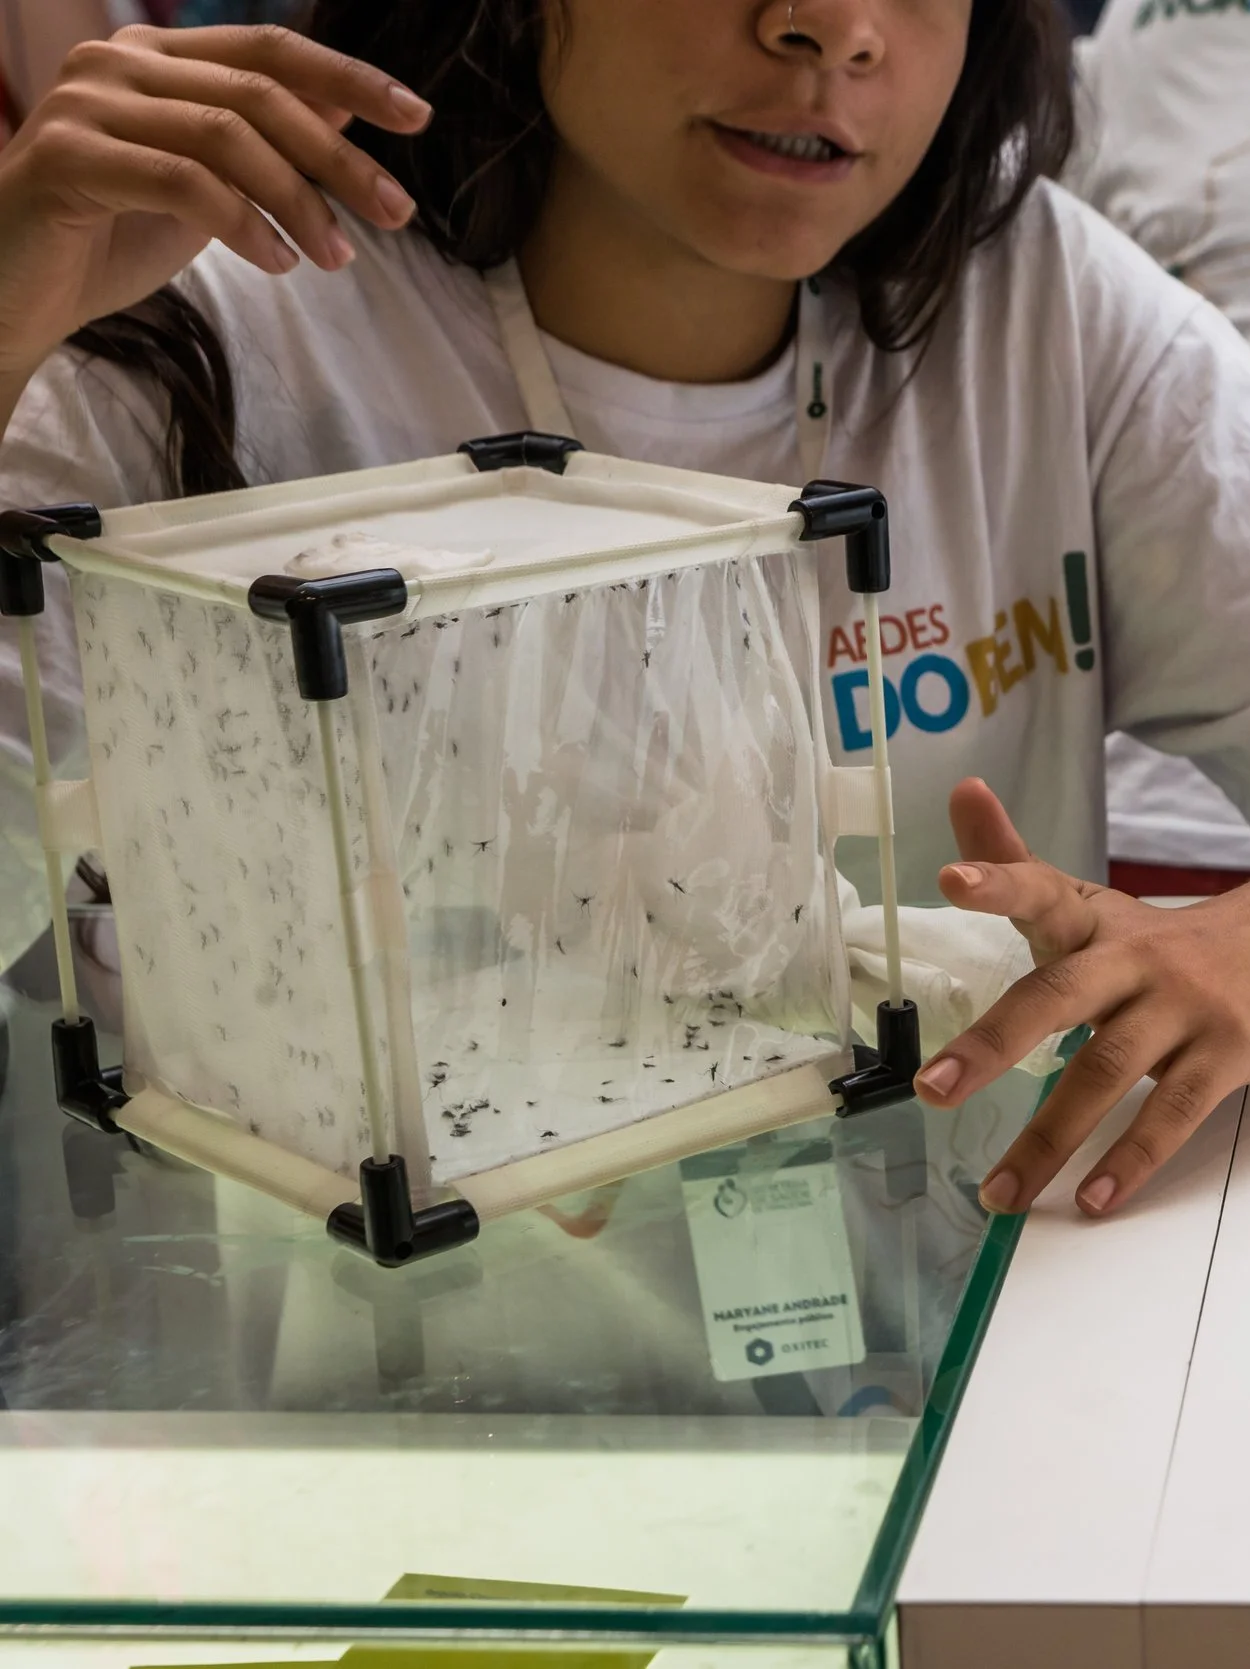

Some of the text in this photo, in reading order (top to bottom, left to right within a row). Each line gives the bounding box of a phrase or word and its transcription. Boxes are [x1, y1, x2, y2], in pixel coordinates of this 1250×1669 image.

[827, 604, 950, 668] AEDES
[832, 653, 970, 752] DO
[713, 1294, 847, 1321] MARYANE ANDRADE
